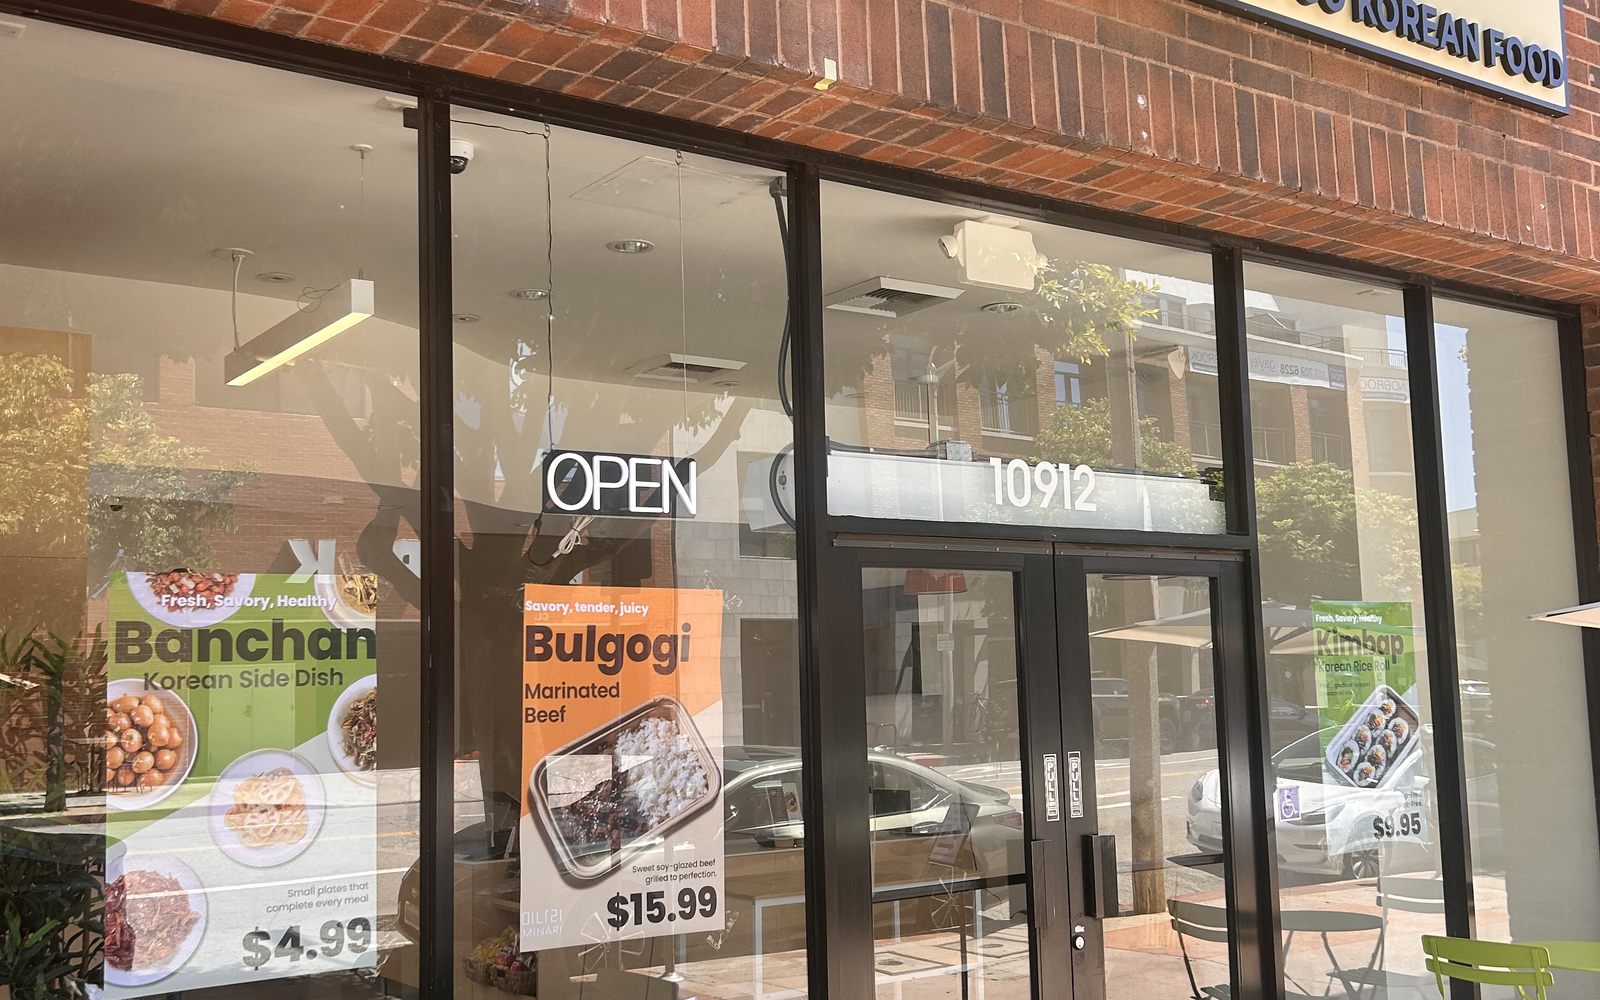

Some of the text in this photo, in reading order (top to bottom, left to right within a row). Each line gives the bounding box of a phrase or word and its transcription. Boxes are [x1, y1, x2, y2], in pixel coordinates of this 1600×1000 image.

[1352, 0, 1564, 89] KOREAN FOOD
[546, 452, 698, 515] OPEN
[990, 457, 1098, 513] 10912
[161, 594, 337, 612] Fresh, Savory, Healthy
[524, 600, 649, 617] Savory, tender, juicy
[115, 618, 377, 664] Banchan
[525, 622, 692, 676] Bulgogi
[1317, 626, 1404, 665] Kimbap
[144, 667, 344, 691] Korean Side Dish
[1318, 660, 1390, 673] Korean Rice Roll
[525, 682, 620, 699] Marinated
[525, 705, 566, 723] Beef
[1047, 762, 1056, 802] PULL
[1071, 762, 1079, 802] PULL
[1373, 812, 1421, 841] $9.95
[632, 858, 716, 874] Sweet soy-glazed beef
[645, 870, 718, 885] grilled to perfection.
[287, 881, 369, 897] Small plates that
[266, 894, 369, 913] complete every meal
[607, 886, 718, 931] $15.99
[242, 917, 372, 971] $4.99
[522, 925, 562, 937] MINARI
